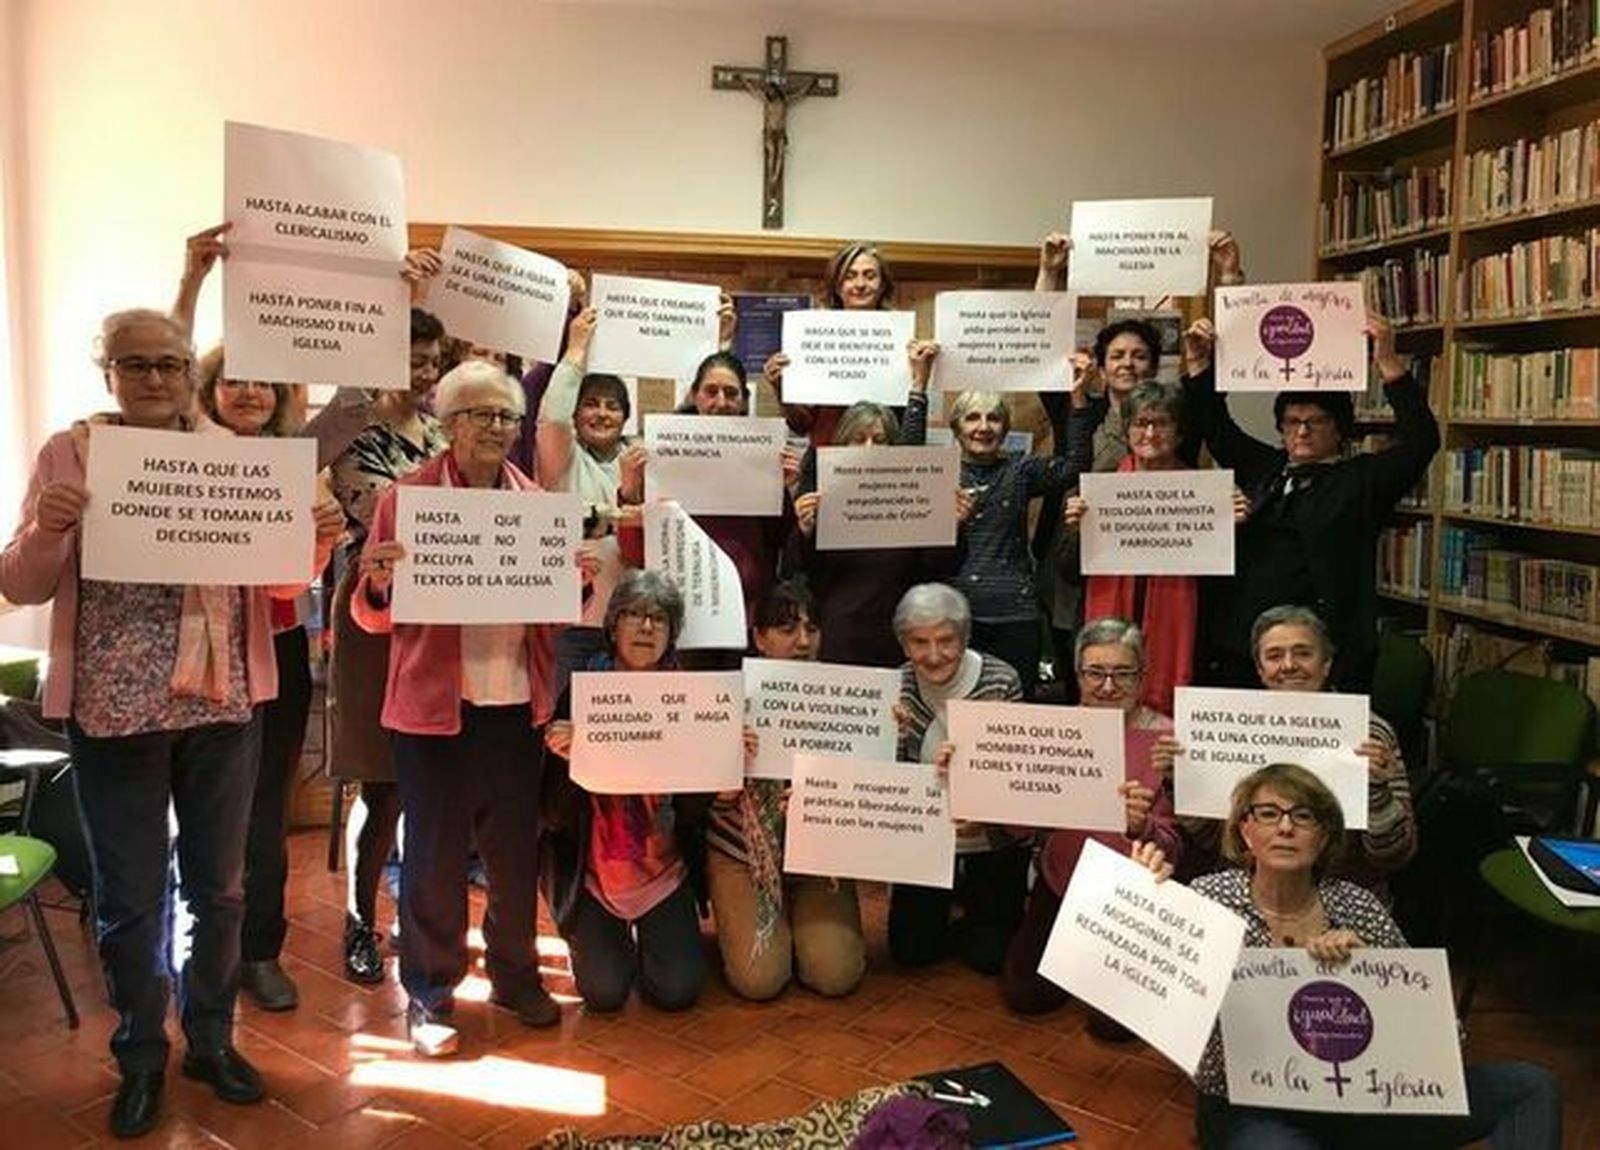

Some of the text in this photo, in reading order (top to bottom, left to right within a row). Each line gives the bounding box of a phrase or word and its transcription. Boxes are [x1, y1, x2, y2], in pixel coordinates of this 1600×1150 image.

[246, 198, 392, 228] HASTA ACABAR CON EL
[275, 221, 369, 244] CLERICALISMO
[1089, 230, 1189, 241] HASTA PONER FIN AL
[1094, 245, 1181, 256] MACHISMO EN LA
[455, 248, 556, 286] HASTA QUE LA IGLESIA
[1119, 260, 1155, 270] IGLESIA
[445, 277, 505, 305] DE IGUALES
[451, 263, 555, 302] SEA UNA COMUNIDAD
[249, 291, 385, 316] HASTA PONER FIN AL
[258, 312, 375, 335] MACHISMO EN LA
[639, 325, 671, 337] NEGRA
[292, 336, 341, 351] IGLESIA
[656, 431, 773, 446] HASTA QUE TENGAMOS
[656, 445, 722, 459] UNA NUNCIA
[143, 456, 271, 479] HASTA QUE LAS
[126, 479, 283, 502] MUJERES ESTEMOS
[1117, 488, 1196, 502] HASTA QUE LA
[111, 501, 295, 524] DONDE SE TOMAN LAS
[414, 510, 568, 529] HASTA QUE EL
[1155, 504, 1216, 517] FEMINISTA
[1099, 520, 1215, 534] SE DIVULGUE EN LAS
[155, 528, 252, 546] DECISIONES
[414, 532, 567, 549] LENGUAJE NO NOS
[1119, 536, 1195, 550] PARROQUIAS
[413, 552, 566, 568] EXCLUYA EN LOS
[412, 573, 554, 587] TEXTOS DE LA IGLESIA
[590, 691, 731, 706] HASTA QUE LA
[761, 681, 884, 700] HASTA QUE SE ACABE
[586, 709, 731, 725] IGUALDAD SE HAGA
[763, 699, 878, 717] CON LA VIOLENCIA Y
[756, 717, 771, 728] LA
[865, 724, 880, 737] DE
[1190, 709, 1342, 730] HASTA QUE LA IGLESIA
[586, 729, 663, 743] COSTUMBRE
[986, 722, 1083, 741] HASTA QUE LOS
[1190, 729, 1341, 750] SEA UNA COMUNIDAD
[783, 737, 853, 753] LA POBREZA
[976, 740, 1094, 760] HOMBRES PONGAN
[1190, 749, 1268, 766] DE IGUALES
[969, 758, 1103, 779] FLORES Y LIMPIEN LAS
[805, 775, 942, 798] Hasta recuperar las
[1008, 779, 1062, 796] IGLESIAS
[858, 798, 942, 817] liberadoras de
[834, 816, 924, 834] con las mujeres
[1114, 884, 1206, 940] HASTA QUE LA
[1102, 902, 1201, 966] MISOGINIA SEA
[1075, 911, 1208, 998] RECHAZADA POR TODA
[1103, 953, 1169, 1000] LA IGLESIA
[1350, 958, 1432, 991] mujeres
[1251, 1057, 1446, 1109] en la Iglesia
